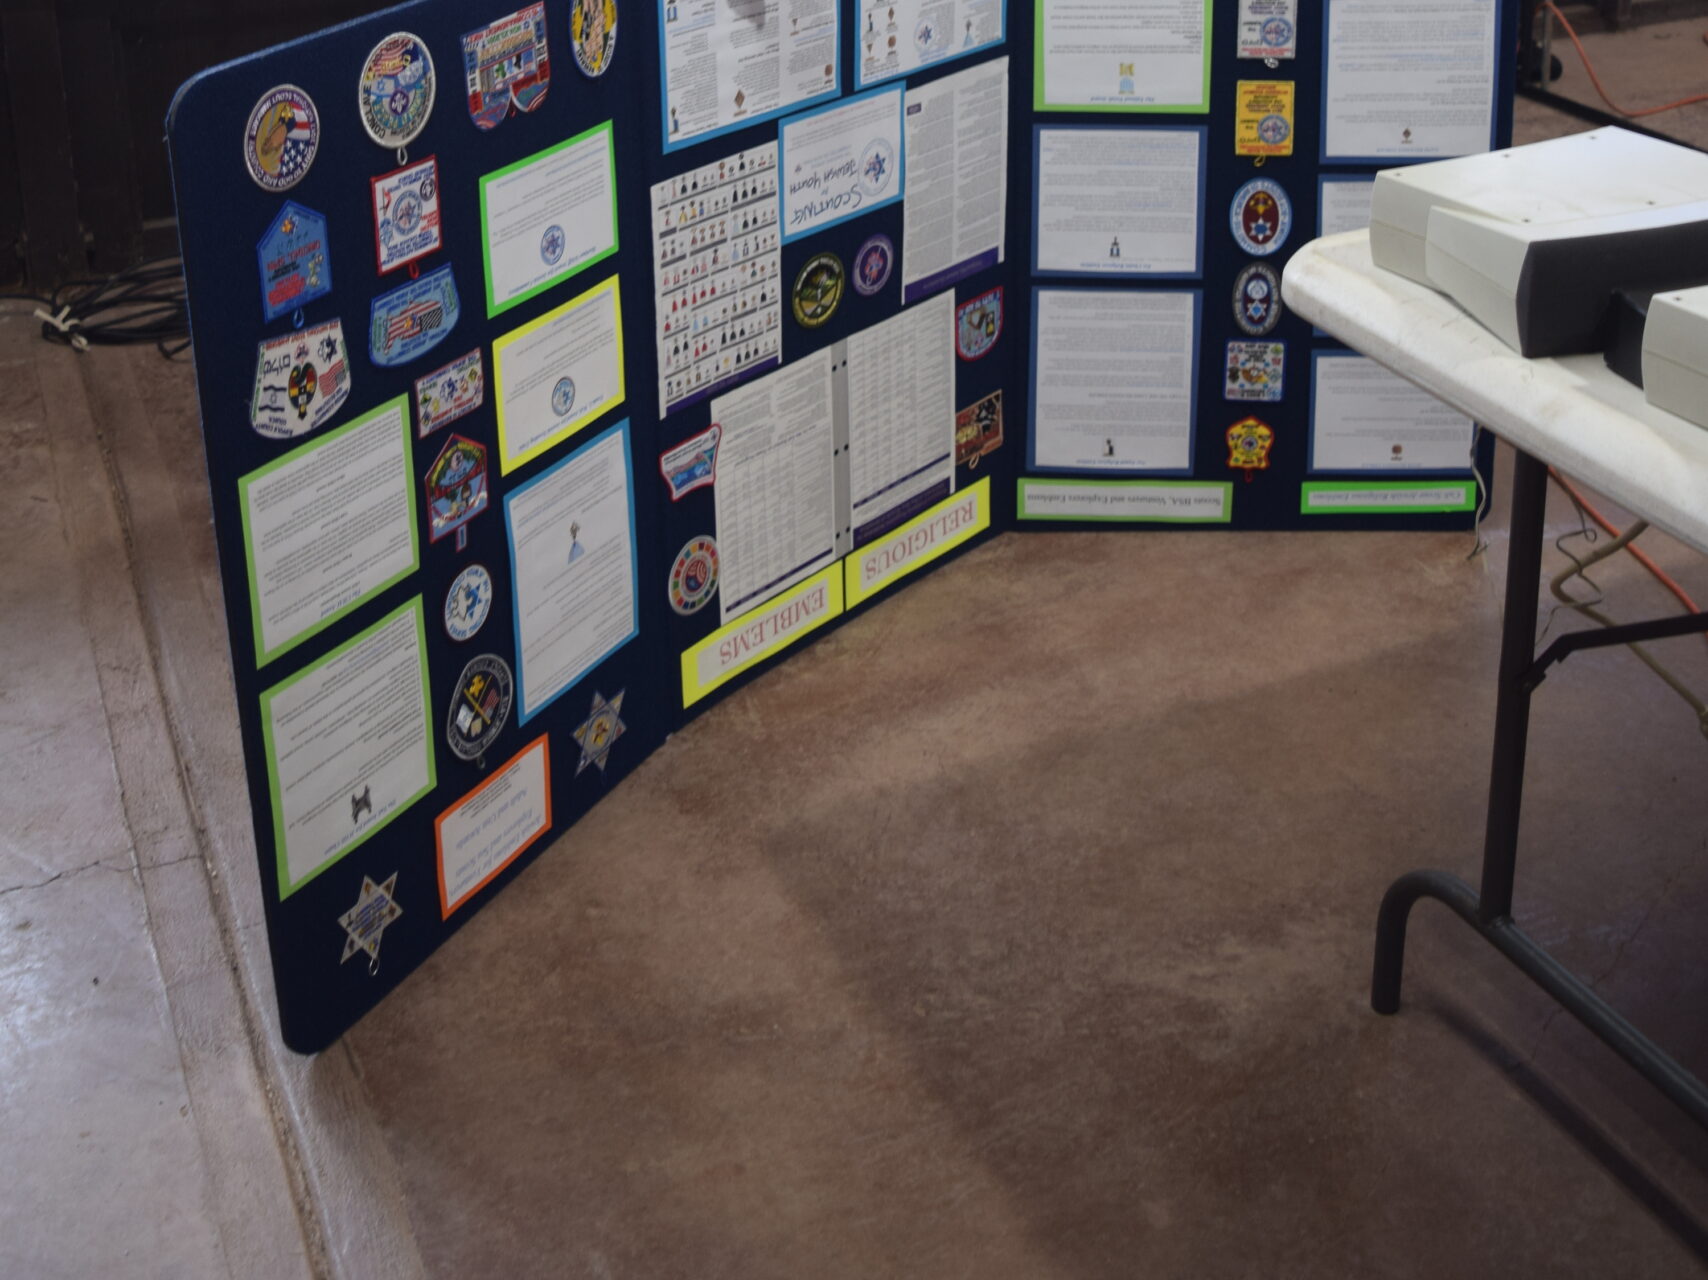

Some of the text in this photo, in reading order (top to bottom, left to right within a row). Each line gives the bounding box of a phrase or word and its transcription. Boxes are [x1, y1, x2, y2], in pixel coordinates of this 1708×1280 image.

[361, 84, 386, 140] CONCLAVE
[789, 159, 858, 196] JEWISH YOUTH
[790, 183, 863, 226] SCOUTING
[717, 499, 976, 666] RELIGIOUS EMBLEMS
